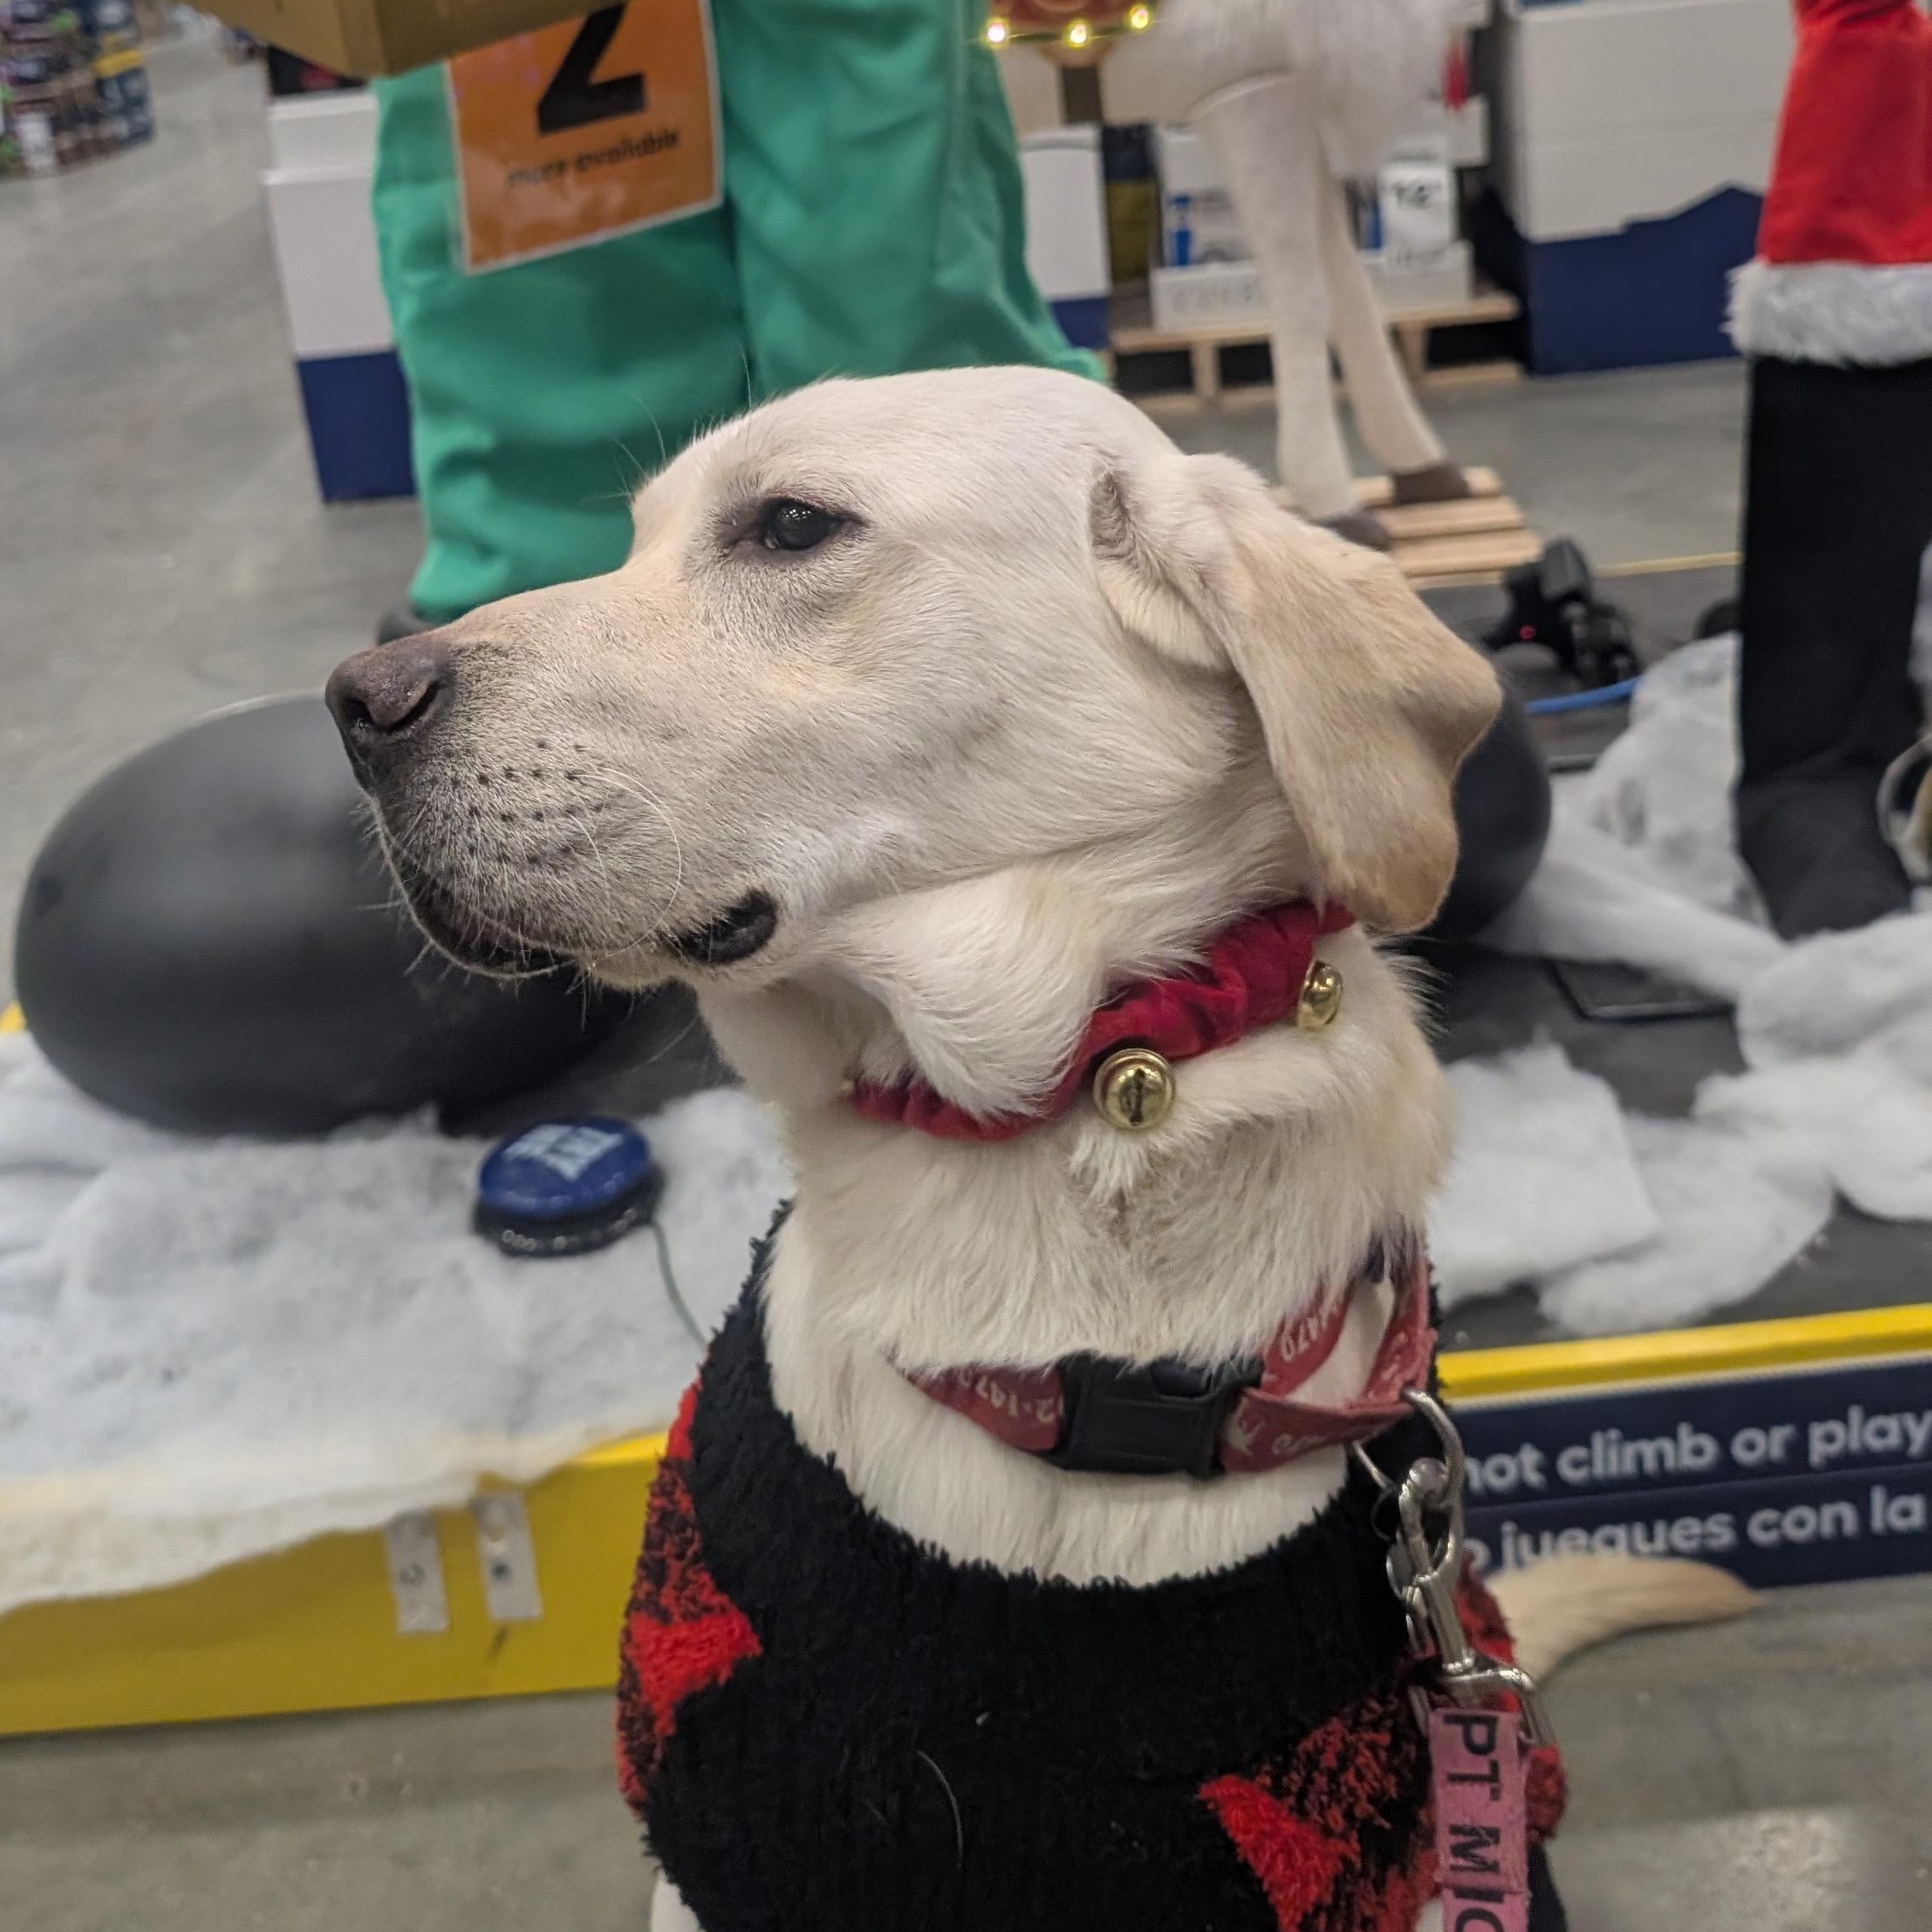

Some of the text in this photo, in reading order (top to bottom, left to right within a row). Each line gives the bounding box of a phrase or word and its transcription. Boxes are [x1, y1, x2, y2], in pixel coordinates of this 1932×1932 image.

[576, 131, 678, 171] available
[1464, 1403, 1932, 1495] not climb or play
[1746, 1501, 1859, 1547] con
[1870, 1484, 1927, 1537] la
[1443, 1713, 1501, 1802] PT
